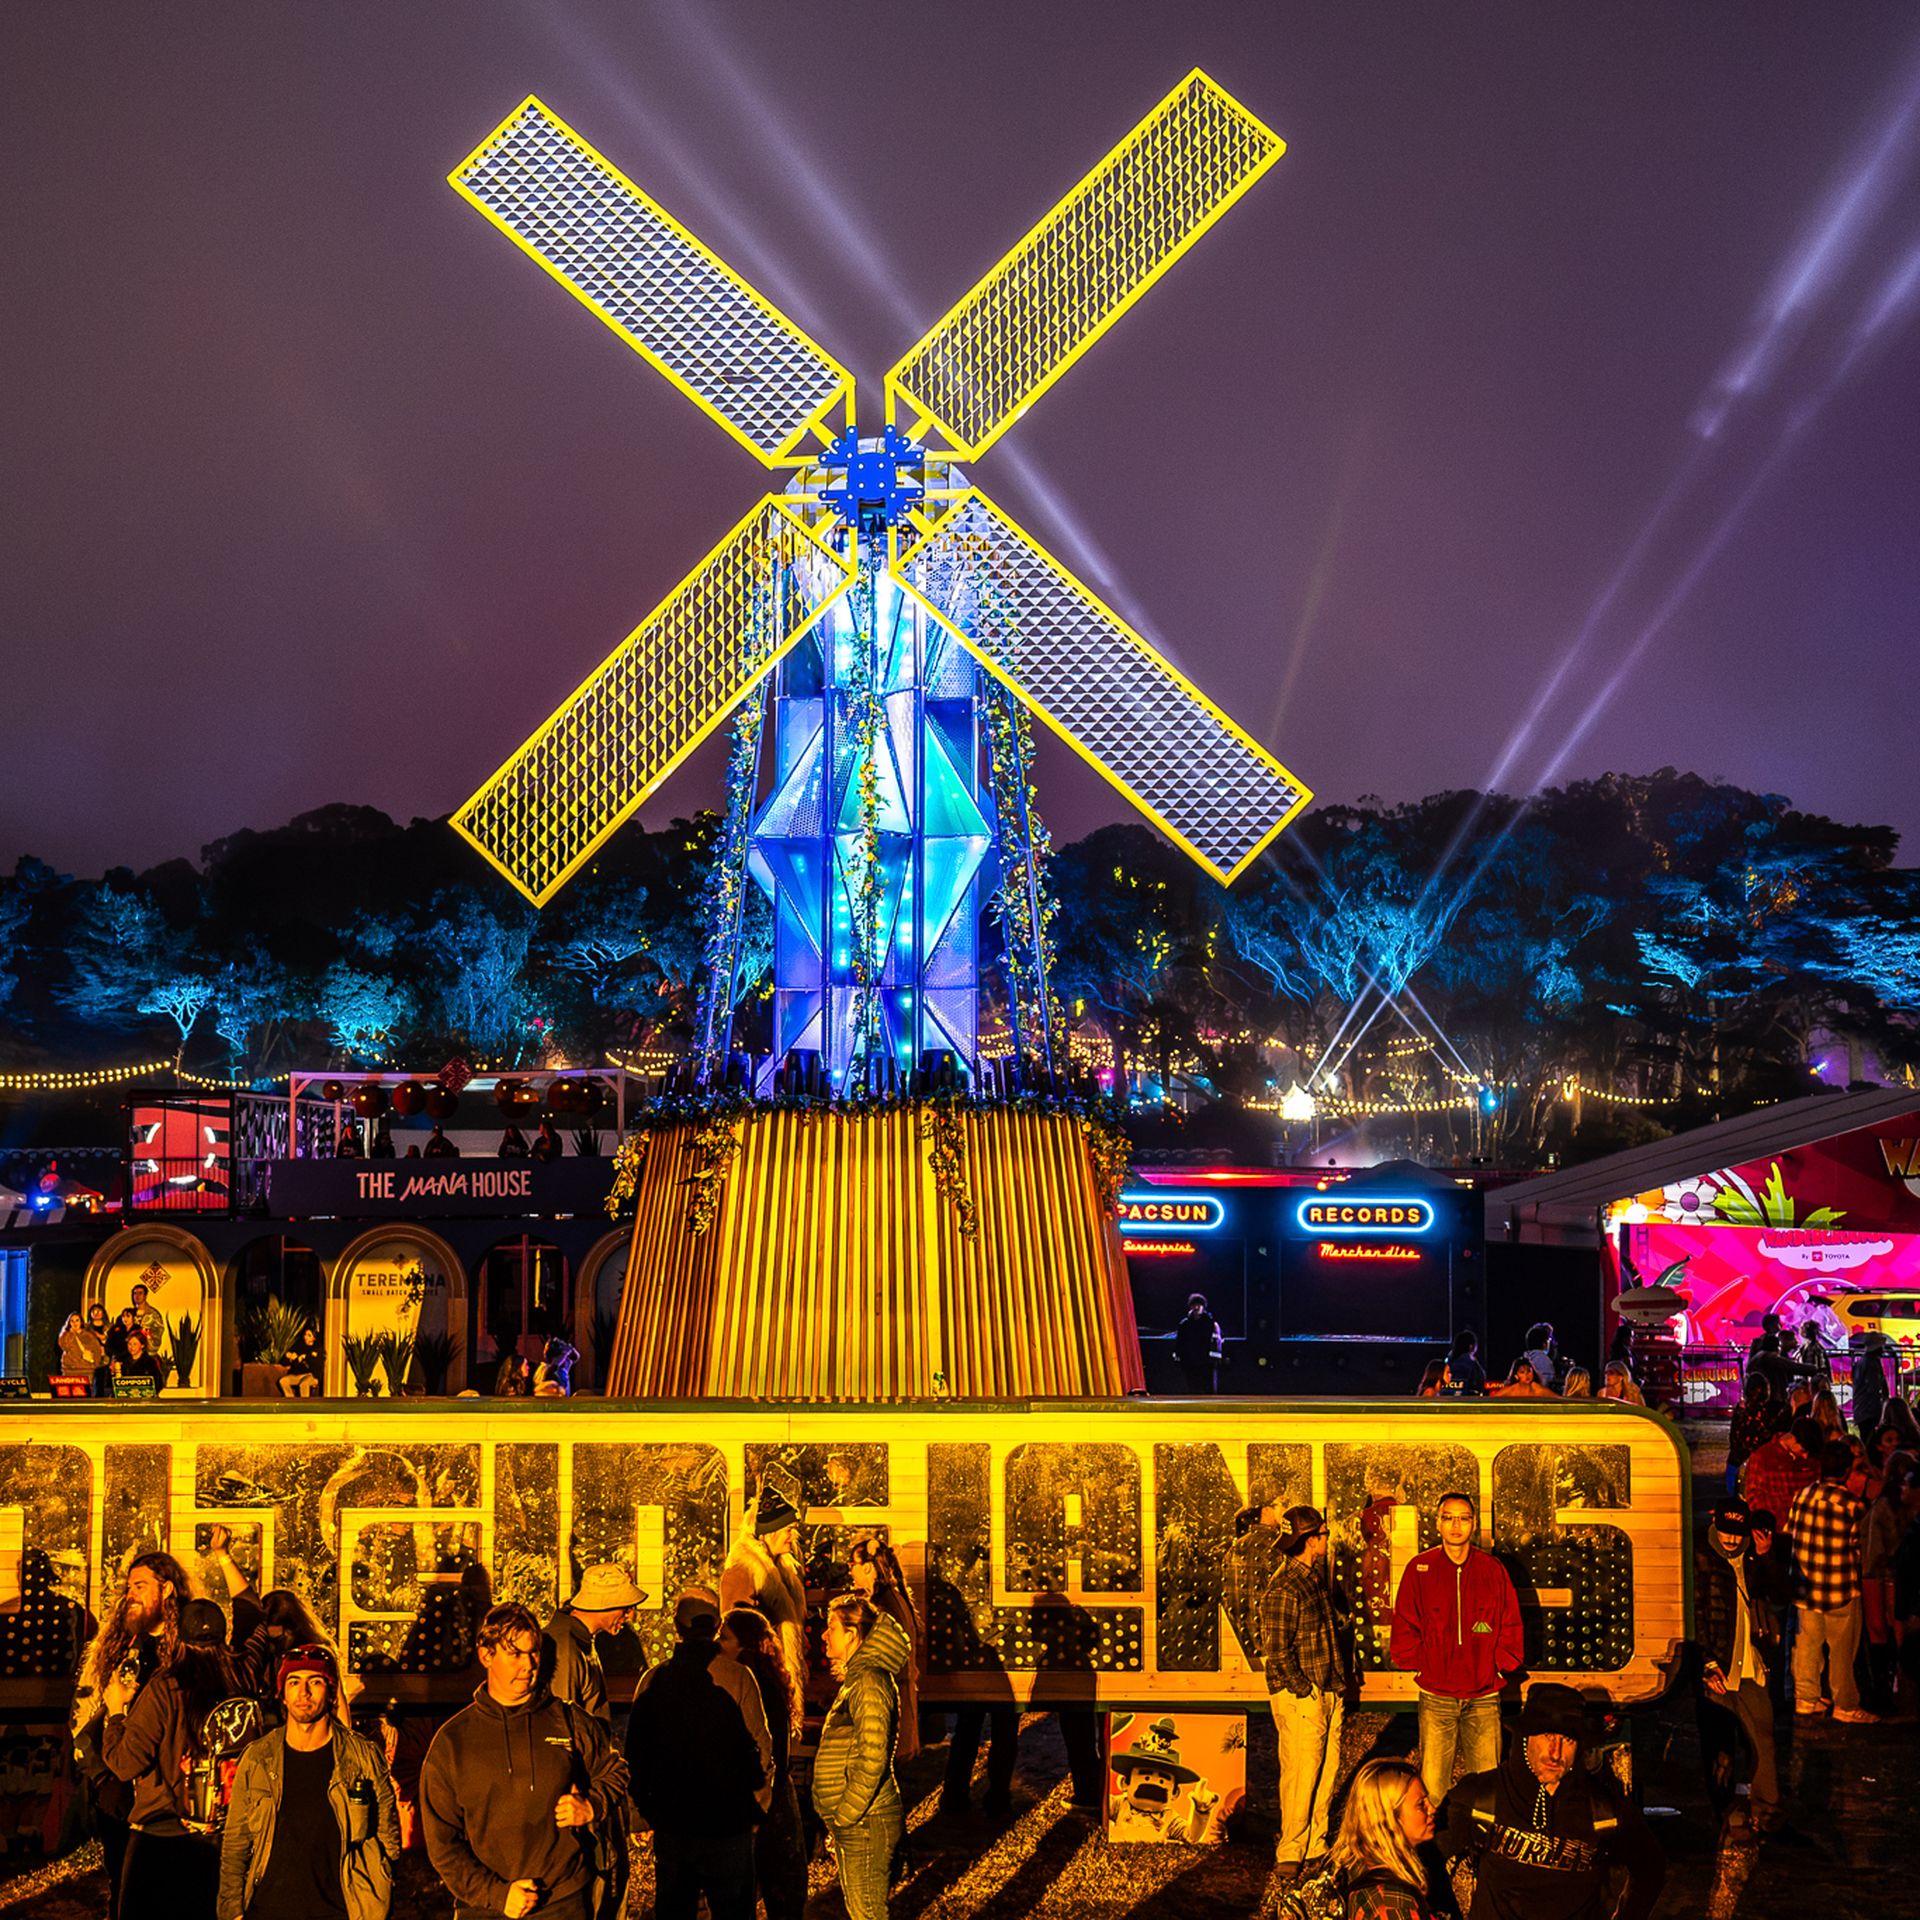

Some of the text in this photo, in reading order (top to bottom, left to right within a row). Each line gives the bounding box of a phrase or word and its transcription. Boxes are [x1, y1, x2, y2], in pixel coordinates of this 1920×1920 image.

[356, 1170, 532, 1201] THE MANA HOUSE
[1116, 1203, 1208, 1221] PACSUN
[1309, 1206, 1421, 1224] RECORDS
[1122, 1240, 1196, 1254] Screenprint
[1320, 1243, 1421, 1259] Merchandise
[926, 1443, 1634, 1672] LANDS
